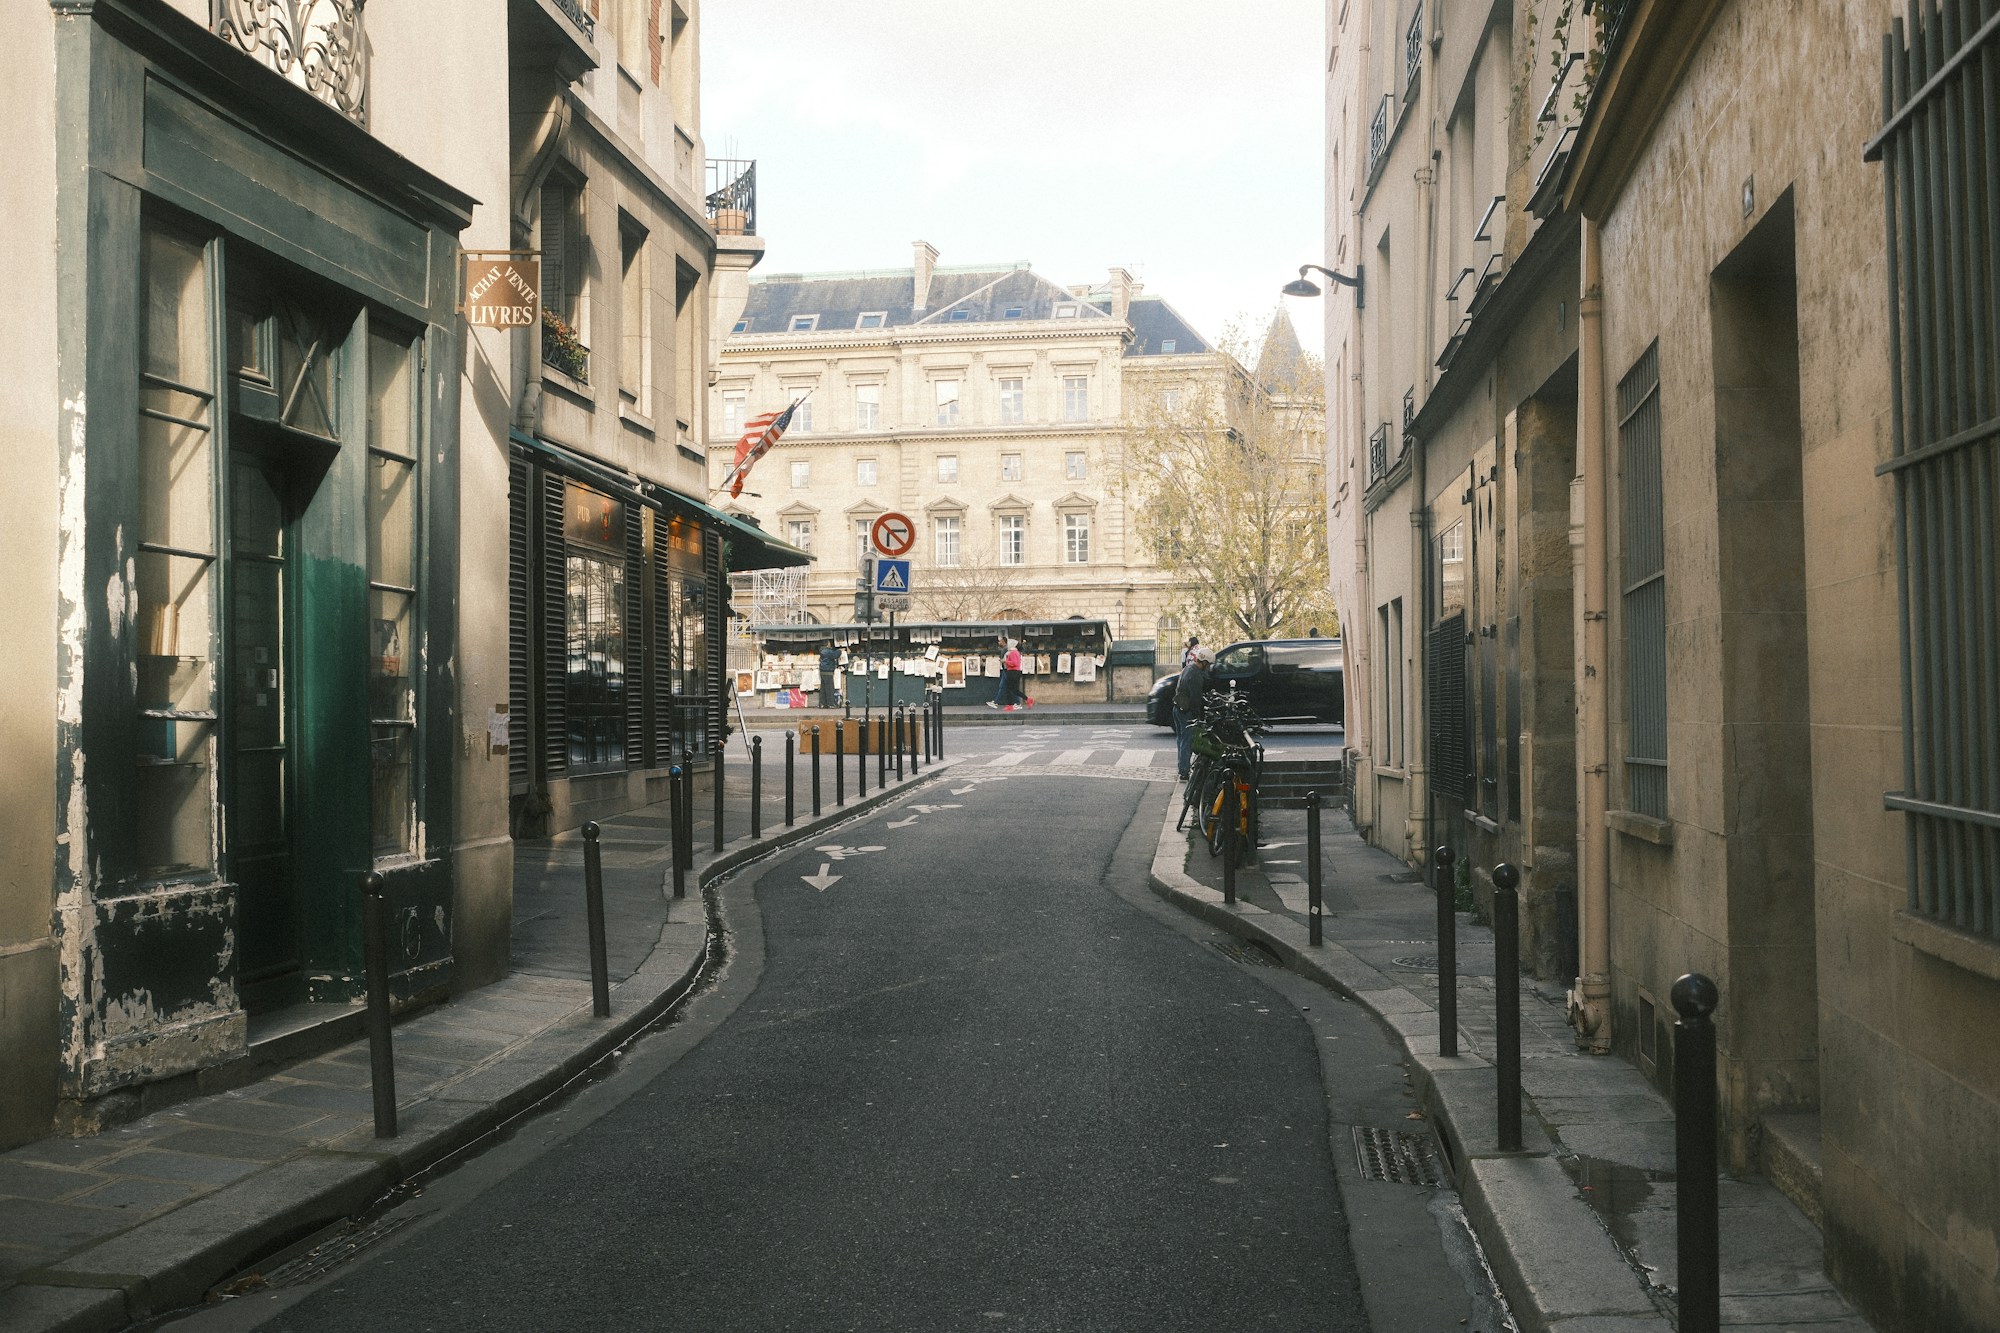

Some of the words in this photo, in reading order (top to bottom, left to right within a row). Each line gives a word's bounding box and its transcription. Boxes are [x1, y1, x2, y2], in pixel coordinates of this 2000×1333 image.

[469, 265, 502, 303] ACHAT
[504, 266, 537, 304] VENTE
[470, 305, 533, 325] LIVRES
[577, 504, 590, 523] PUB
